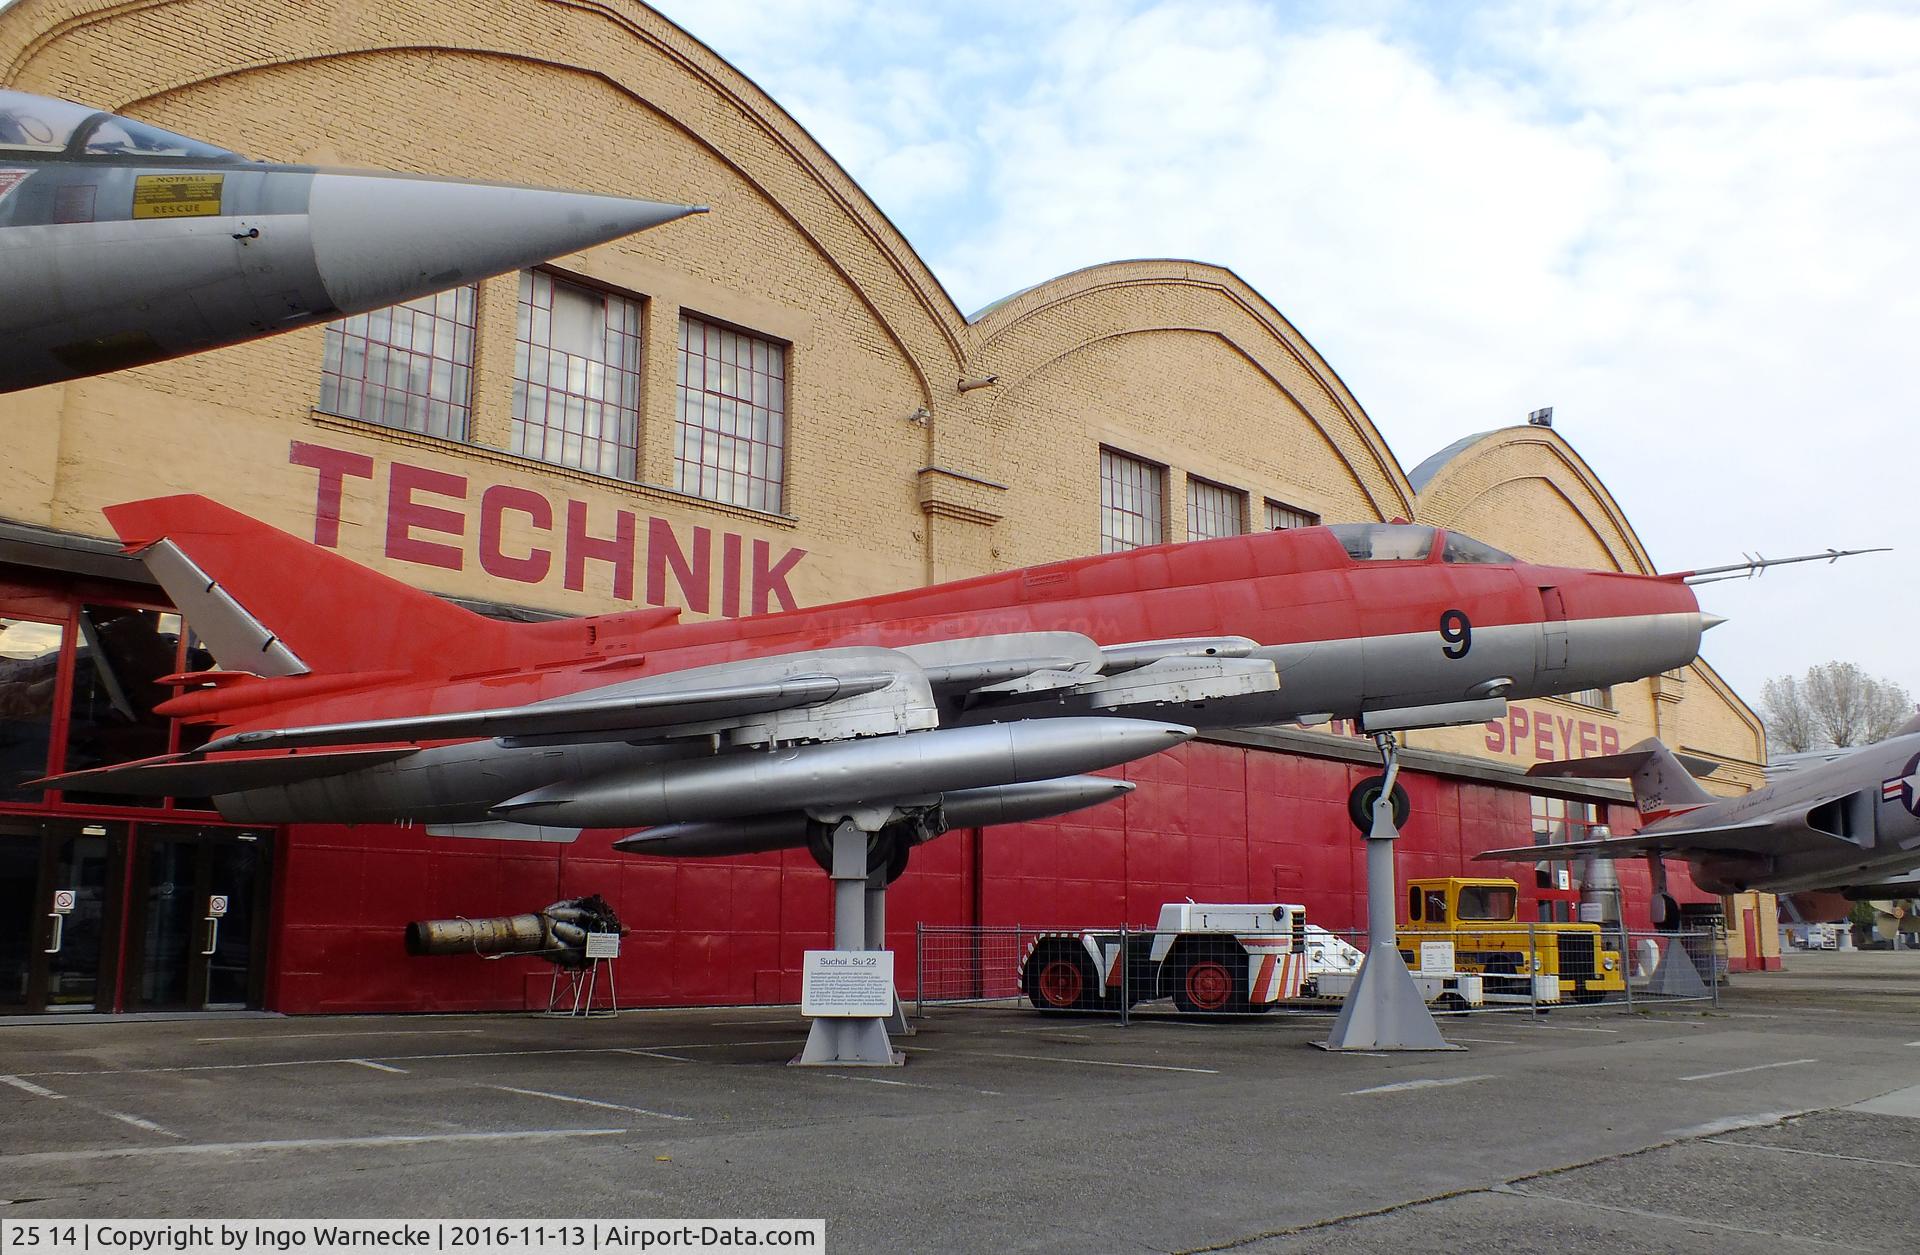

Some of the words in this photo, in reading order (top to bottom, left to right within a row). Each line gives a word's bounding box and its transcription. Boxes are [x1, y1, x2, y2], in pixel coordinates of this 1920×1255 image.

[156, 175, 206, 183] NOTFALL
[153, 204, 201, 214] RESCUE
[290, 440, 807, 618] TECHNIK
[1440, 609, 1472, 660] 9
[1485, 706, 1620, 761] SPEYER
[820, 957, 848, 966] Suchoi
